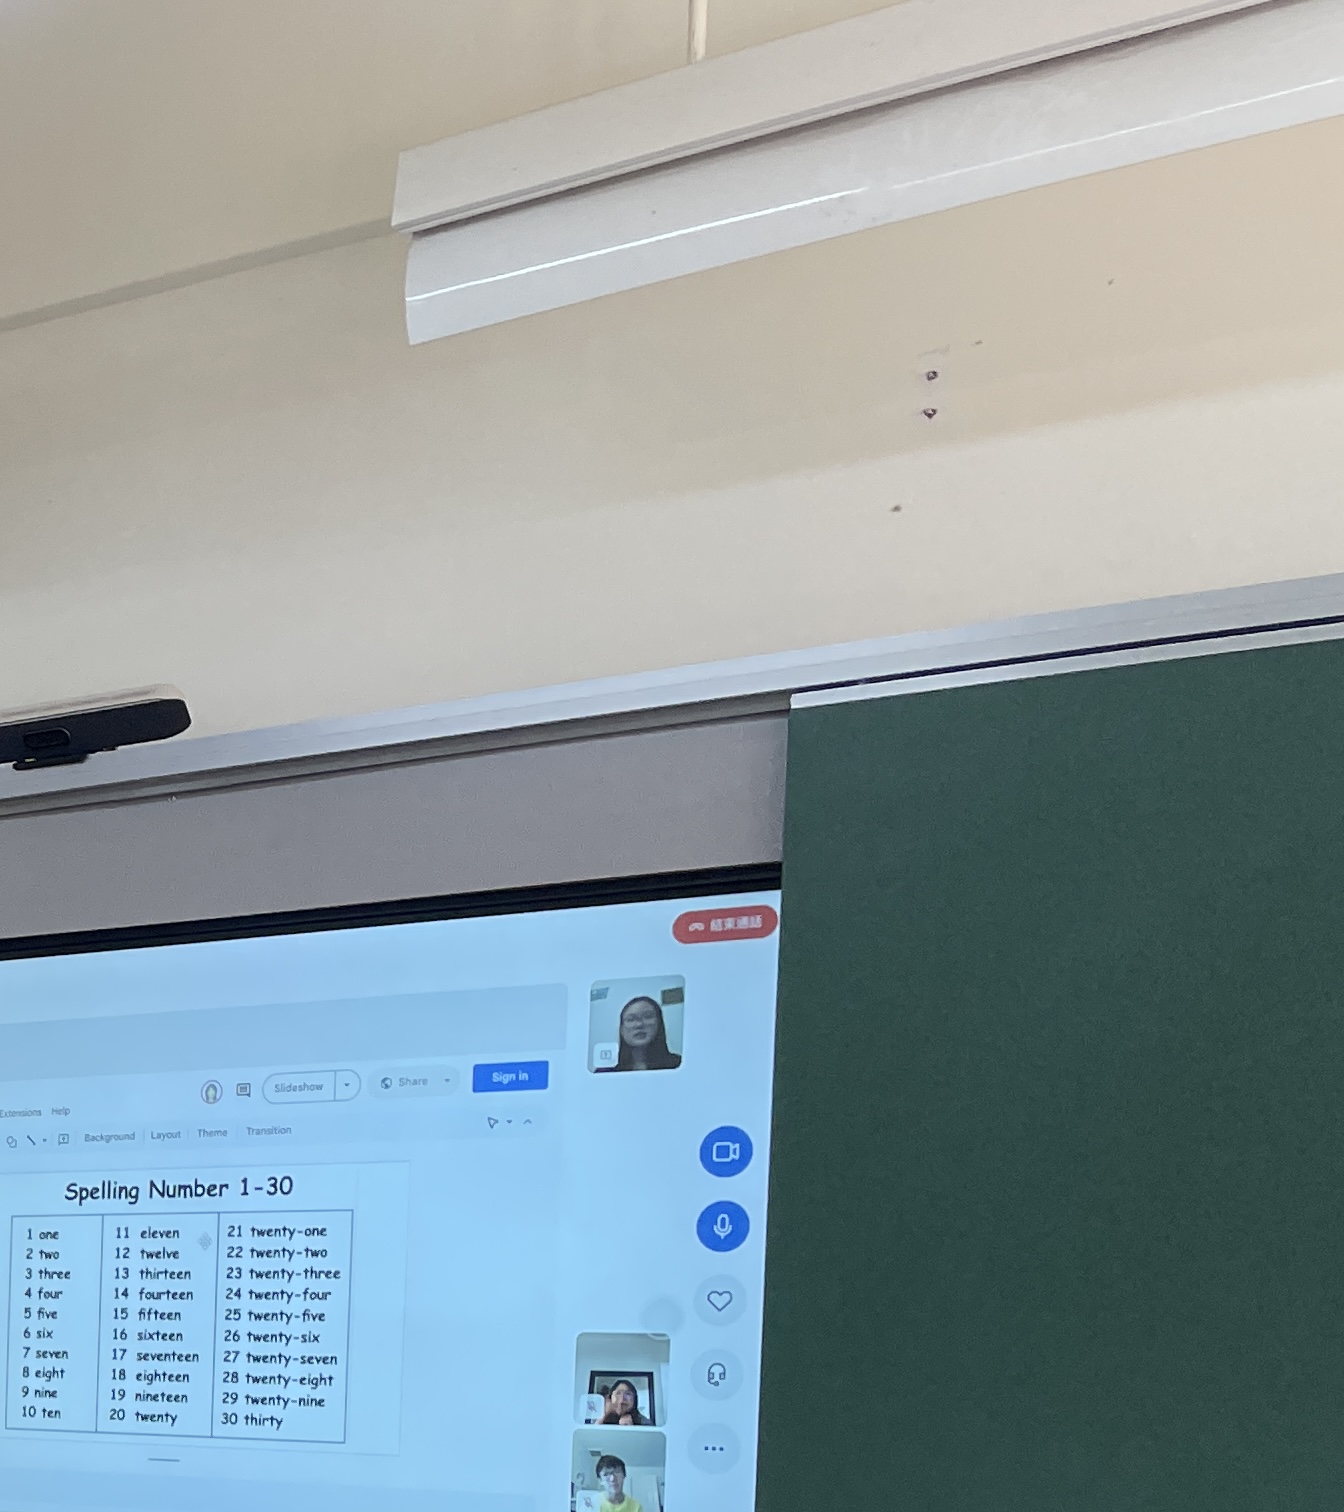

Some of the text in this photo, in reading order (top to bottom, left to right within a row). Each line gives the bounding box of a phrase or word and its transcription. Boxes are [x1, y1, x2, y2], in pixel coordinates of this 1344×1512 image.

[398, 1077, 428, 1087] Share
[492, 1070, 529, 1083] Sign in
[274, 1081, 324, 1093] Slideshow
[0, 1108, 42, 1119] Extensions
[51, 1107, 71, 1117] Help
[84, 1131, 136, 1143] Background
[150, 1130, 181, 1141] Layout
[197, 1128, 228, 1138] Theme
[246, 1125, 292, 1136] Transition
[64, 1176, 293, 1205] Spelling Number 1-30
[27, 1229, 59, 1240] 1 one
[116, 1227, 180, 1239] 11 eleven
[228, 1226, 327, 1240] 21 twenty-one
[26, 1249, 59, 1260] 2 two
[115, 1248, 179, 1260] 12 twelve
[227, 1247, 328, 1261] 22 twenty-two
[25, 1269, 71, 1280] 3 three
[115, 1268, 191, 1280] 13 thirteen
[226, 1267, 341, 1283] 23 twenty-three
[24, 1288, 63, 1299] 4 four
[114, 1288, 193, 1300] 14 fourteen
[226, 1289, 332, 1304] 24 twenty-four
[24, 1308, 58, 1320] 5 five
[113, 1309, 181, 1321] 15 fifteen
[225, 1309, 325, 1325] 25 twenty-five
[23, 1328, 53, 1339] 6 six
[112, 1329, 183, 1342] 16 sixteen
[224, 1330, 320, 1346] 26 twenty-six
[23, 1347, 68, 1360] 7 seven
[112, 1349, 199, 1362] 17 seventeen
[223, 1351, 338, 1367] 27 twenty-seven
[22, 1366, 65, 1381] 8 eight
[111, 1369, 189, 1384] 18 eighteen
[222, 1372, 334, 1389] 28 twenty-eight
[22, 1386, 58, 1398] 9 nine
[111, 1389, 188, 1403] 19 nineteen
[222, 1392, 325, 1409] 29 twenty-nine
[22, 1406, 61, 1419] 10 ten
[110, 1409, 177, 1425] 20 twenty
[221, 1413, 283, 1430] 30 thirty
